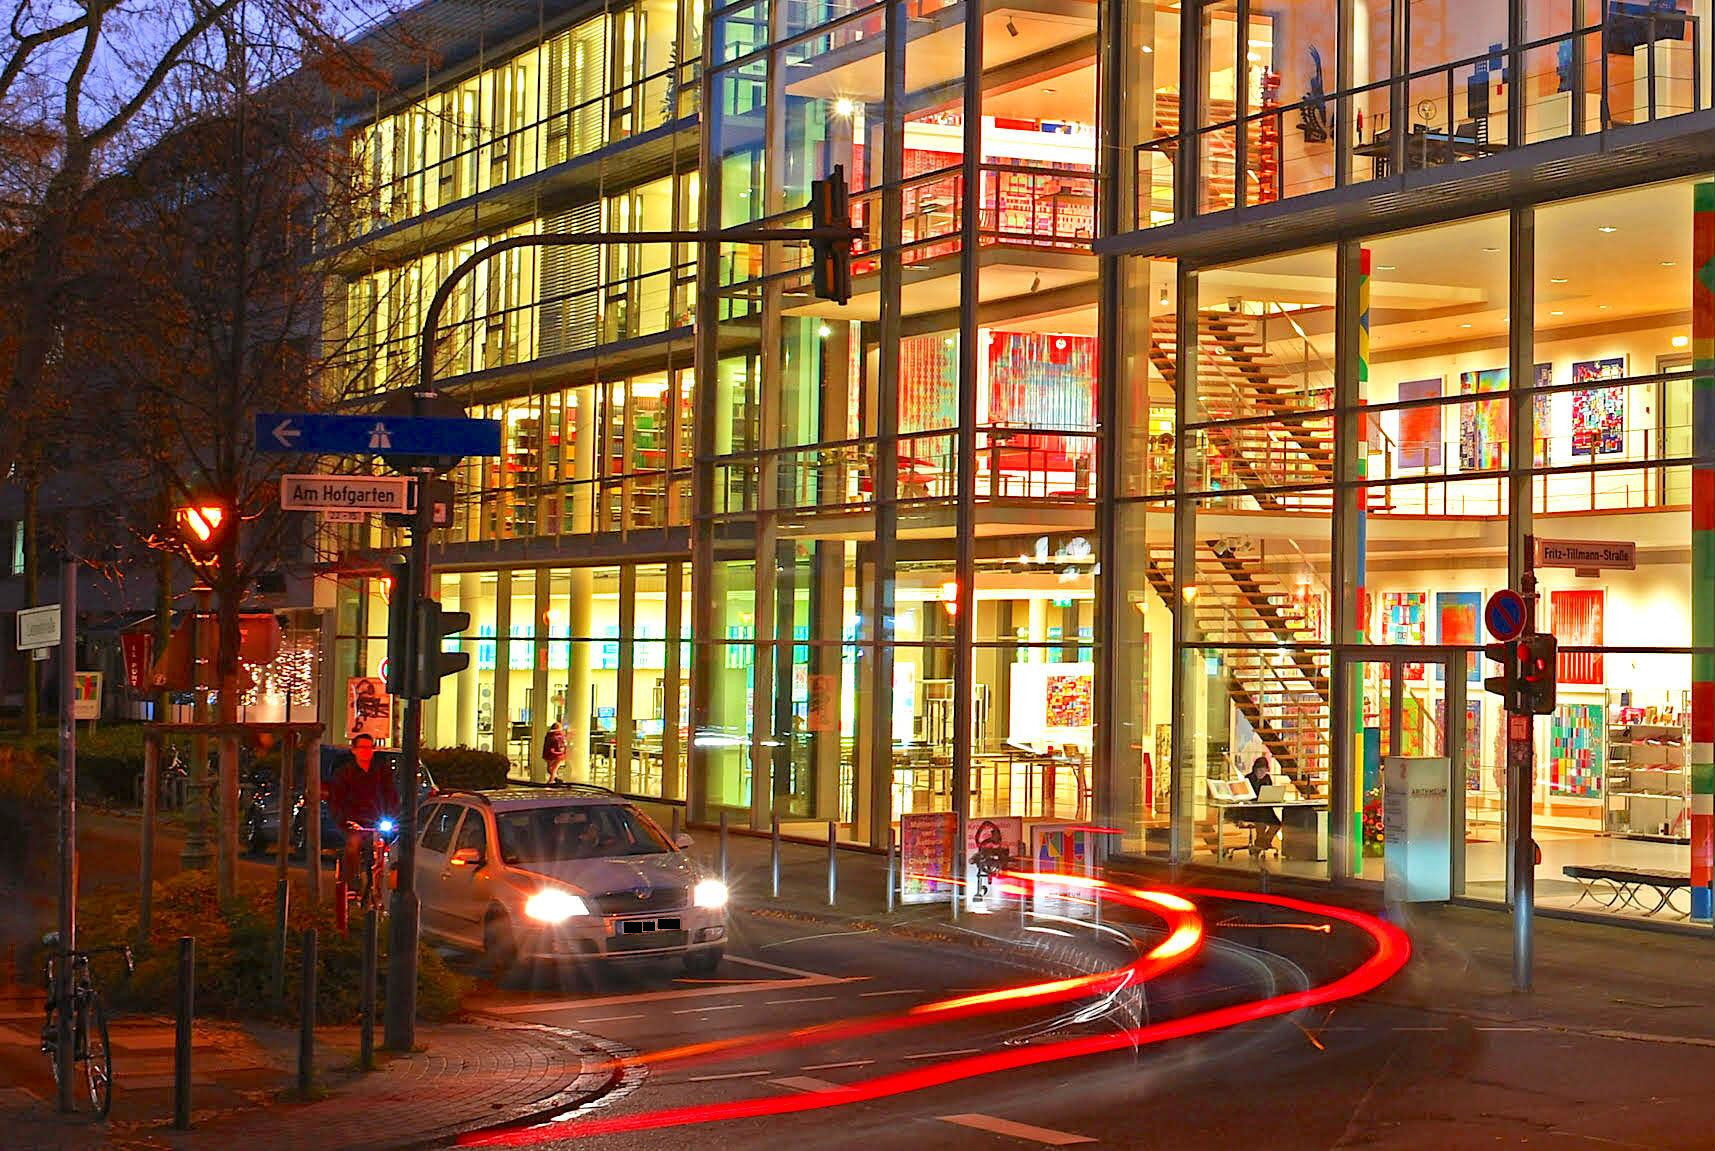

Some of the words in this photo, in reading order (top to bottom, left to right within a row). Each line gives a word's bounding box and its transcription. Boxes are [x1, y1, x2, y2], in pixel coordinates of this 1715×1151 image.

[293, 485, 318, 500] Am
[323, 485, 394, 504] Hofgarten
[1544, 547, 1629, 561] Fritz-Tillmann-Straße
